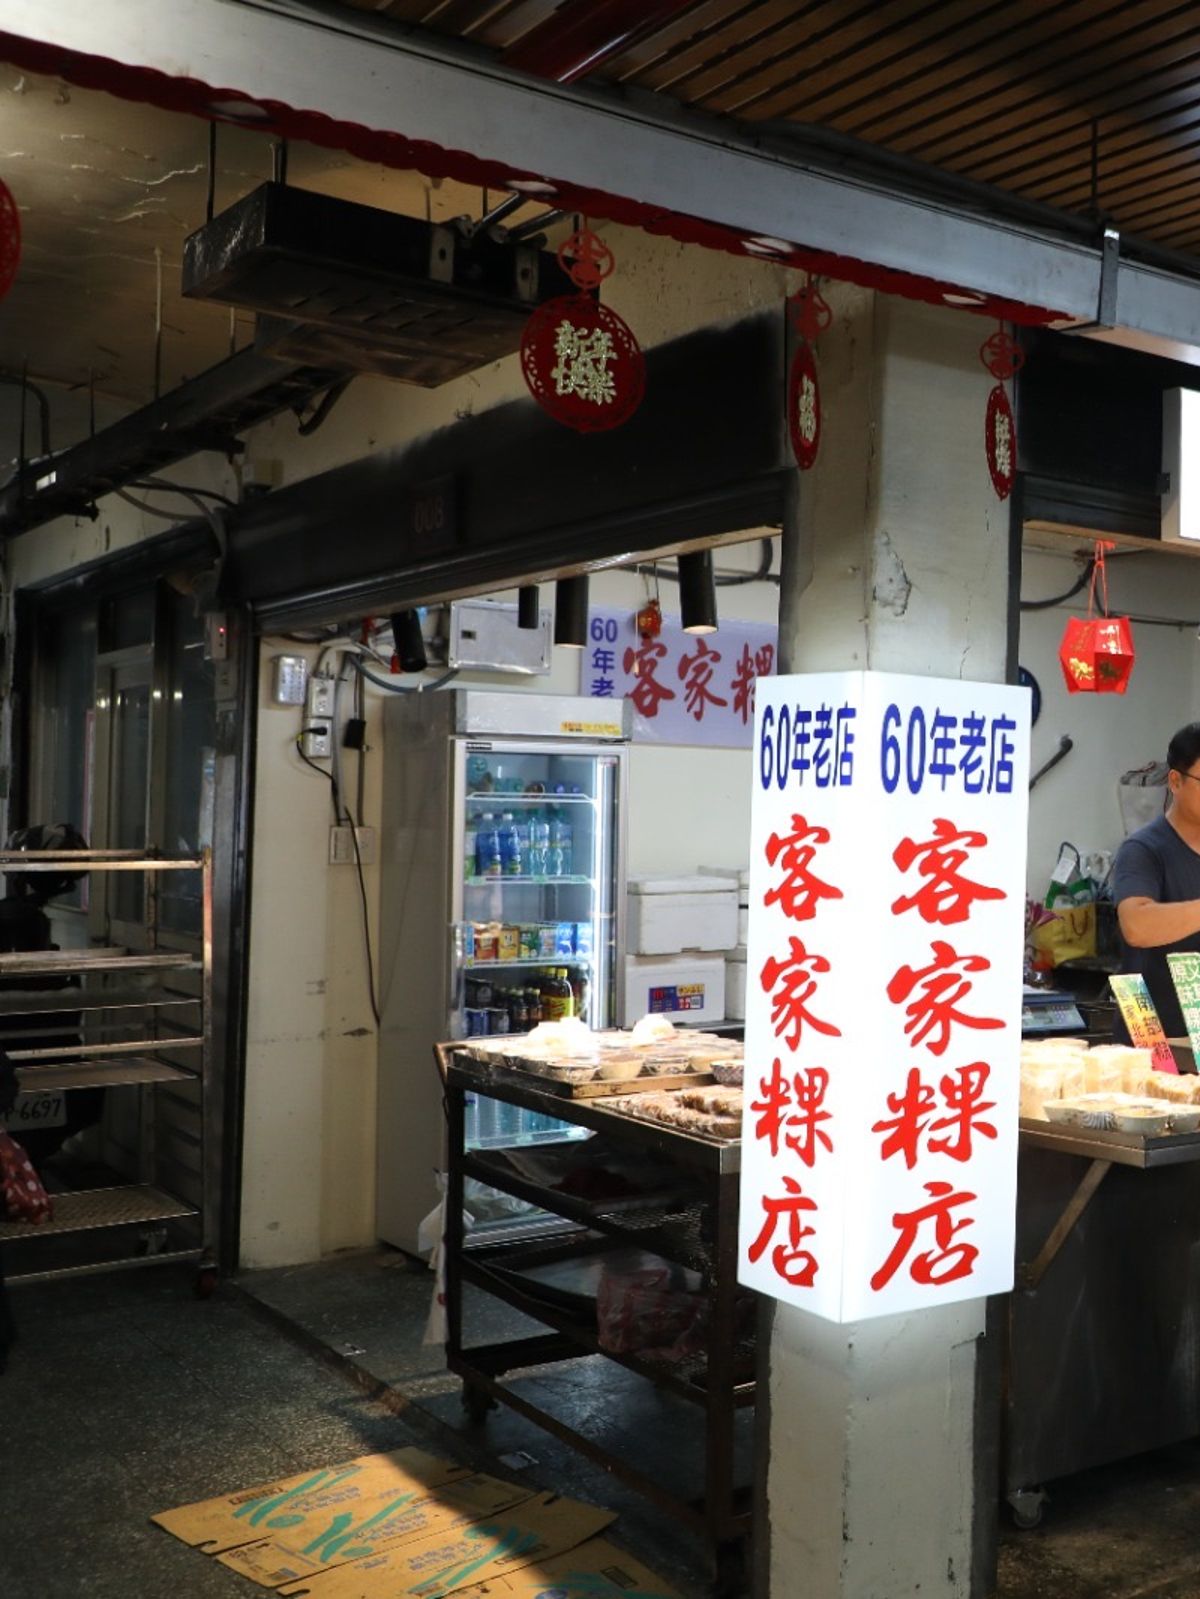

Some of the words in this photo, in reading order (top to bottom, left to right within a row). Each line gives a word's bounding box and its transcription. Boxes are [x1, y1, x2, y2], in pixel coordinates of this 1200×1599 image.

[553, 320, 619, 372] 新年
[760, 701, 857, 791] 60年老店
[880, 703, 1017, 795] 60年老店
[748, 813, 844, 1292] 客家粿店
[870, 818, 1007, 1292] 客家粿店
